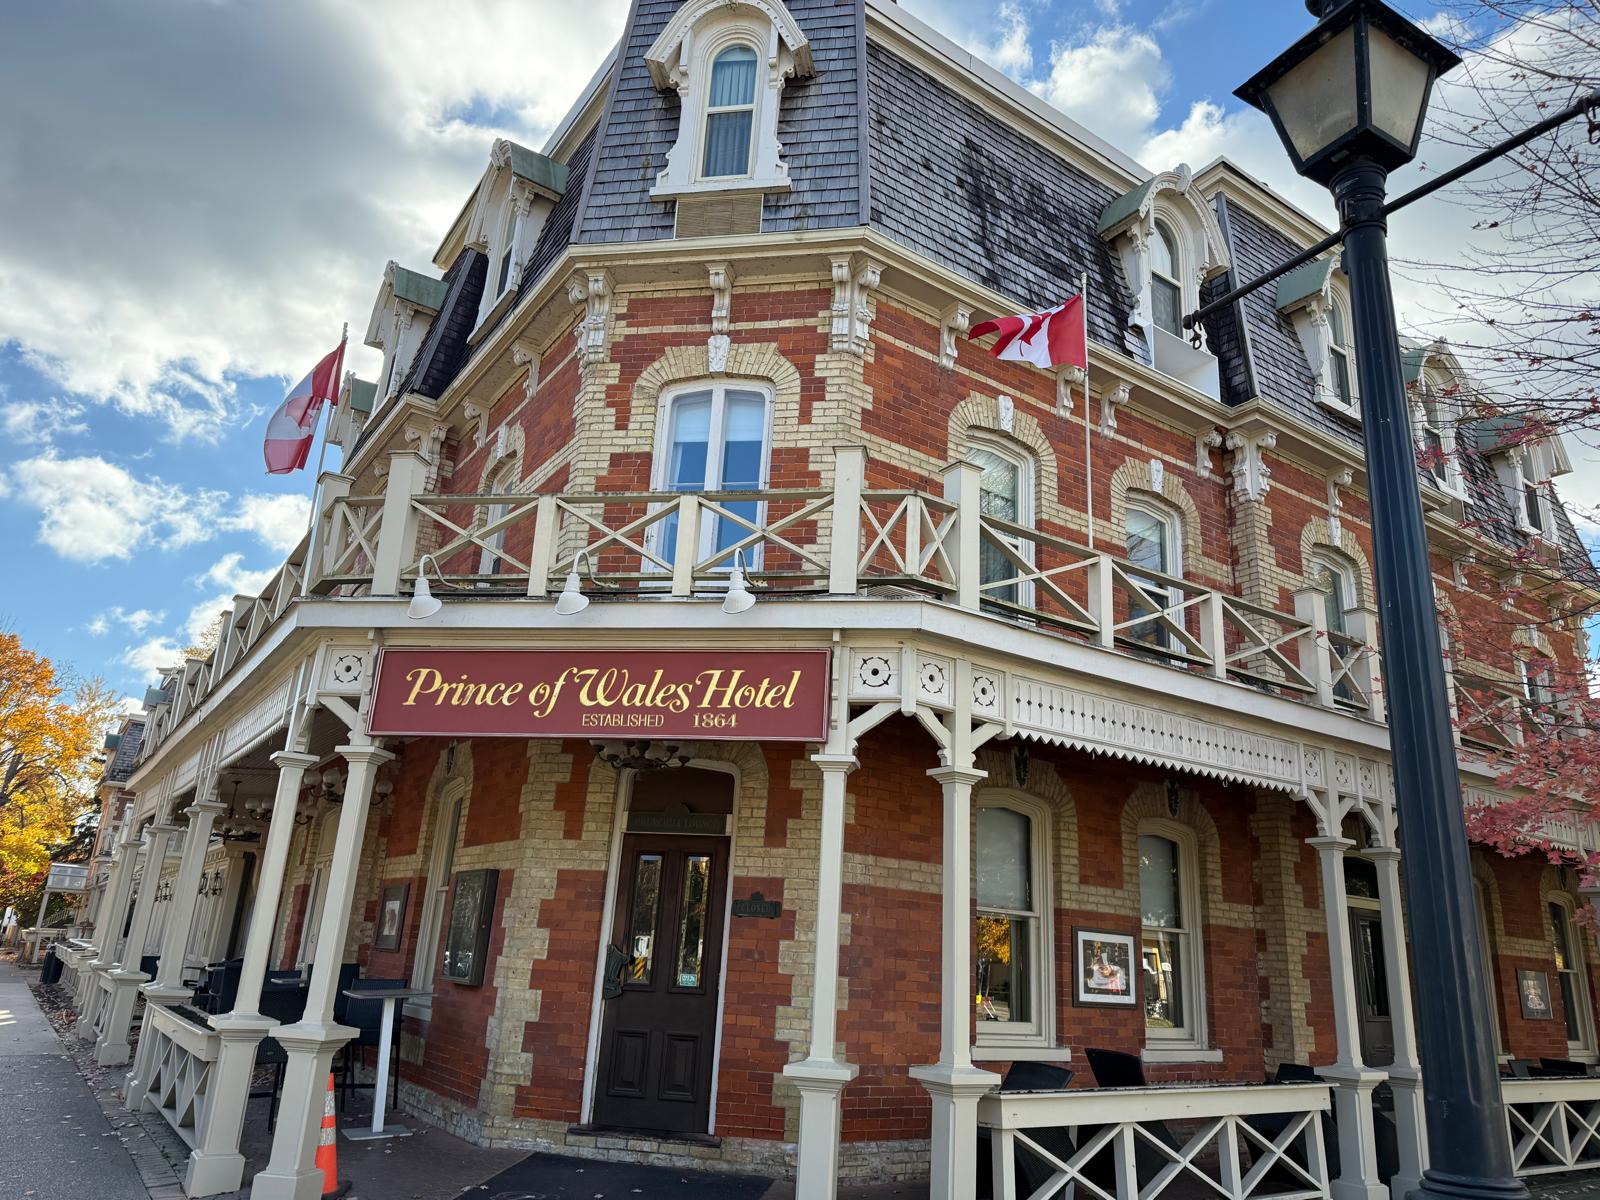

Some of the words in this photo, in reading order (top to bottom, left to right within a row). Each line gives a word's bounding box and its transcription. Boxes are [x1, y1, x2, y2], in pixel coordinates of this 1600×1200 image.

[402, 667, 523, 706] Prince
[528, 667, 578, 718] of
[575, 667, 693, 713] Wales
[695, 669, 801, 709] Hotel
[582, 713, 664, 728] ESTABLISHED
[693, 712, 738, 729] 1864
